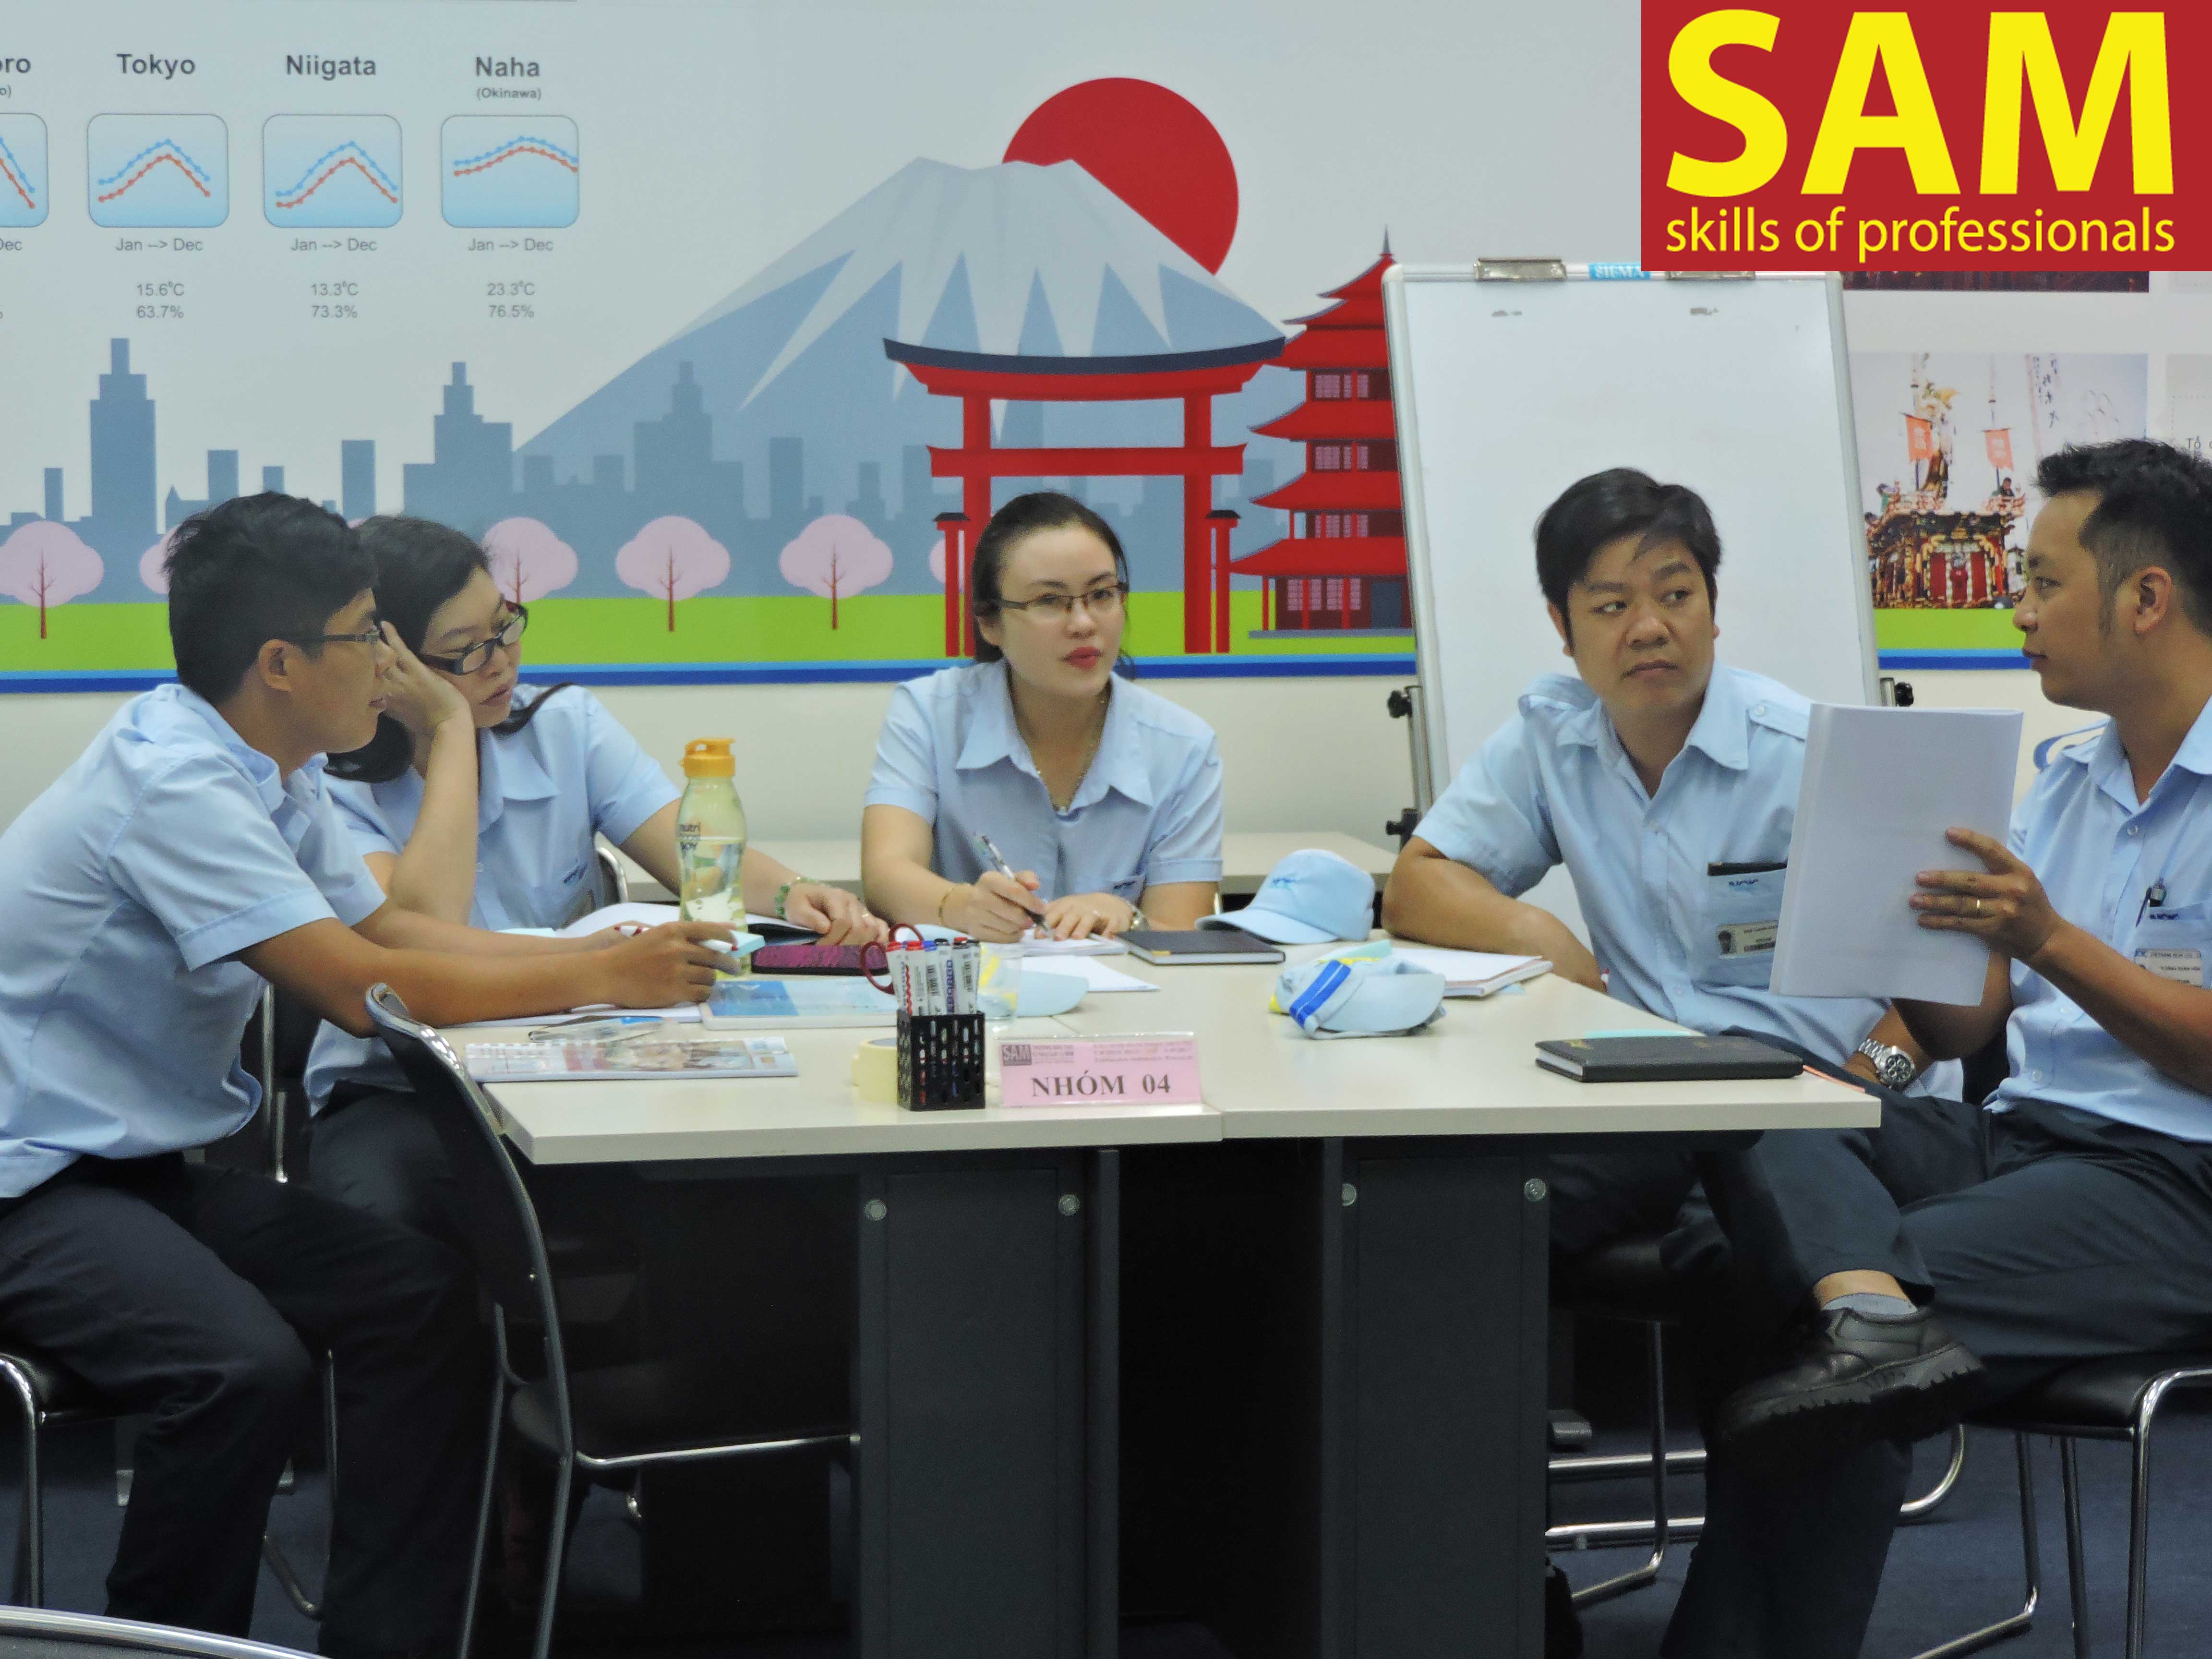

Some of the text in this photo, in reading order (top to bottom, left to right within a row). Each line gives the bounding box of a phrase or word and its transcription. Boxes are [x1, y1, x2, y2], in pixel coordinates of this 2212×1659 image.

[0, 58, 31, 73] ro
[116, 53, 196, 80] Tokyo
[286, 55, 376, 81] Niigata
[475, 56, 540, 77] Naha
[476, 87, 542, 101] (Okinawa)
[116, 238, 204, 251] Jan Dec
[290, 238, 377, 251] Jan Dec
[468, 238, 553, 251] Jan Dec
[136, 304, 184, 318] 63.7%
[311, 304, 358, 318] 73.3%
[488, 304, 534, 318] 76.5%
[1031, 1070, 1171, 1097] NHÓM 04
